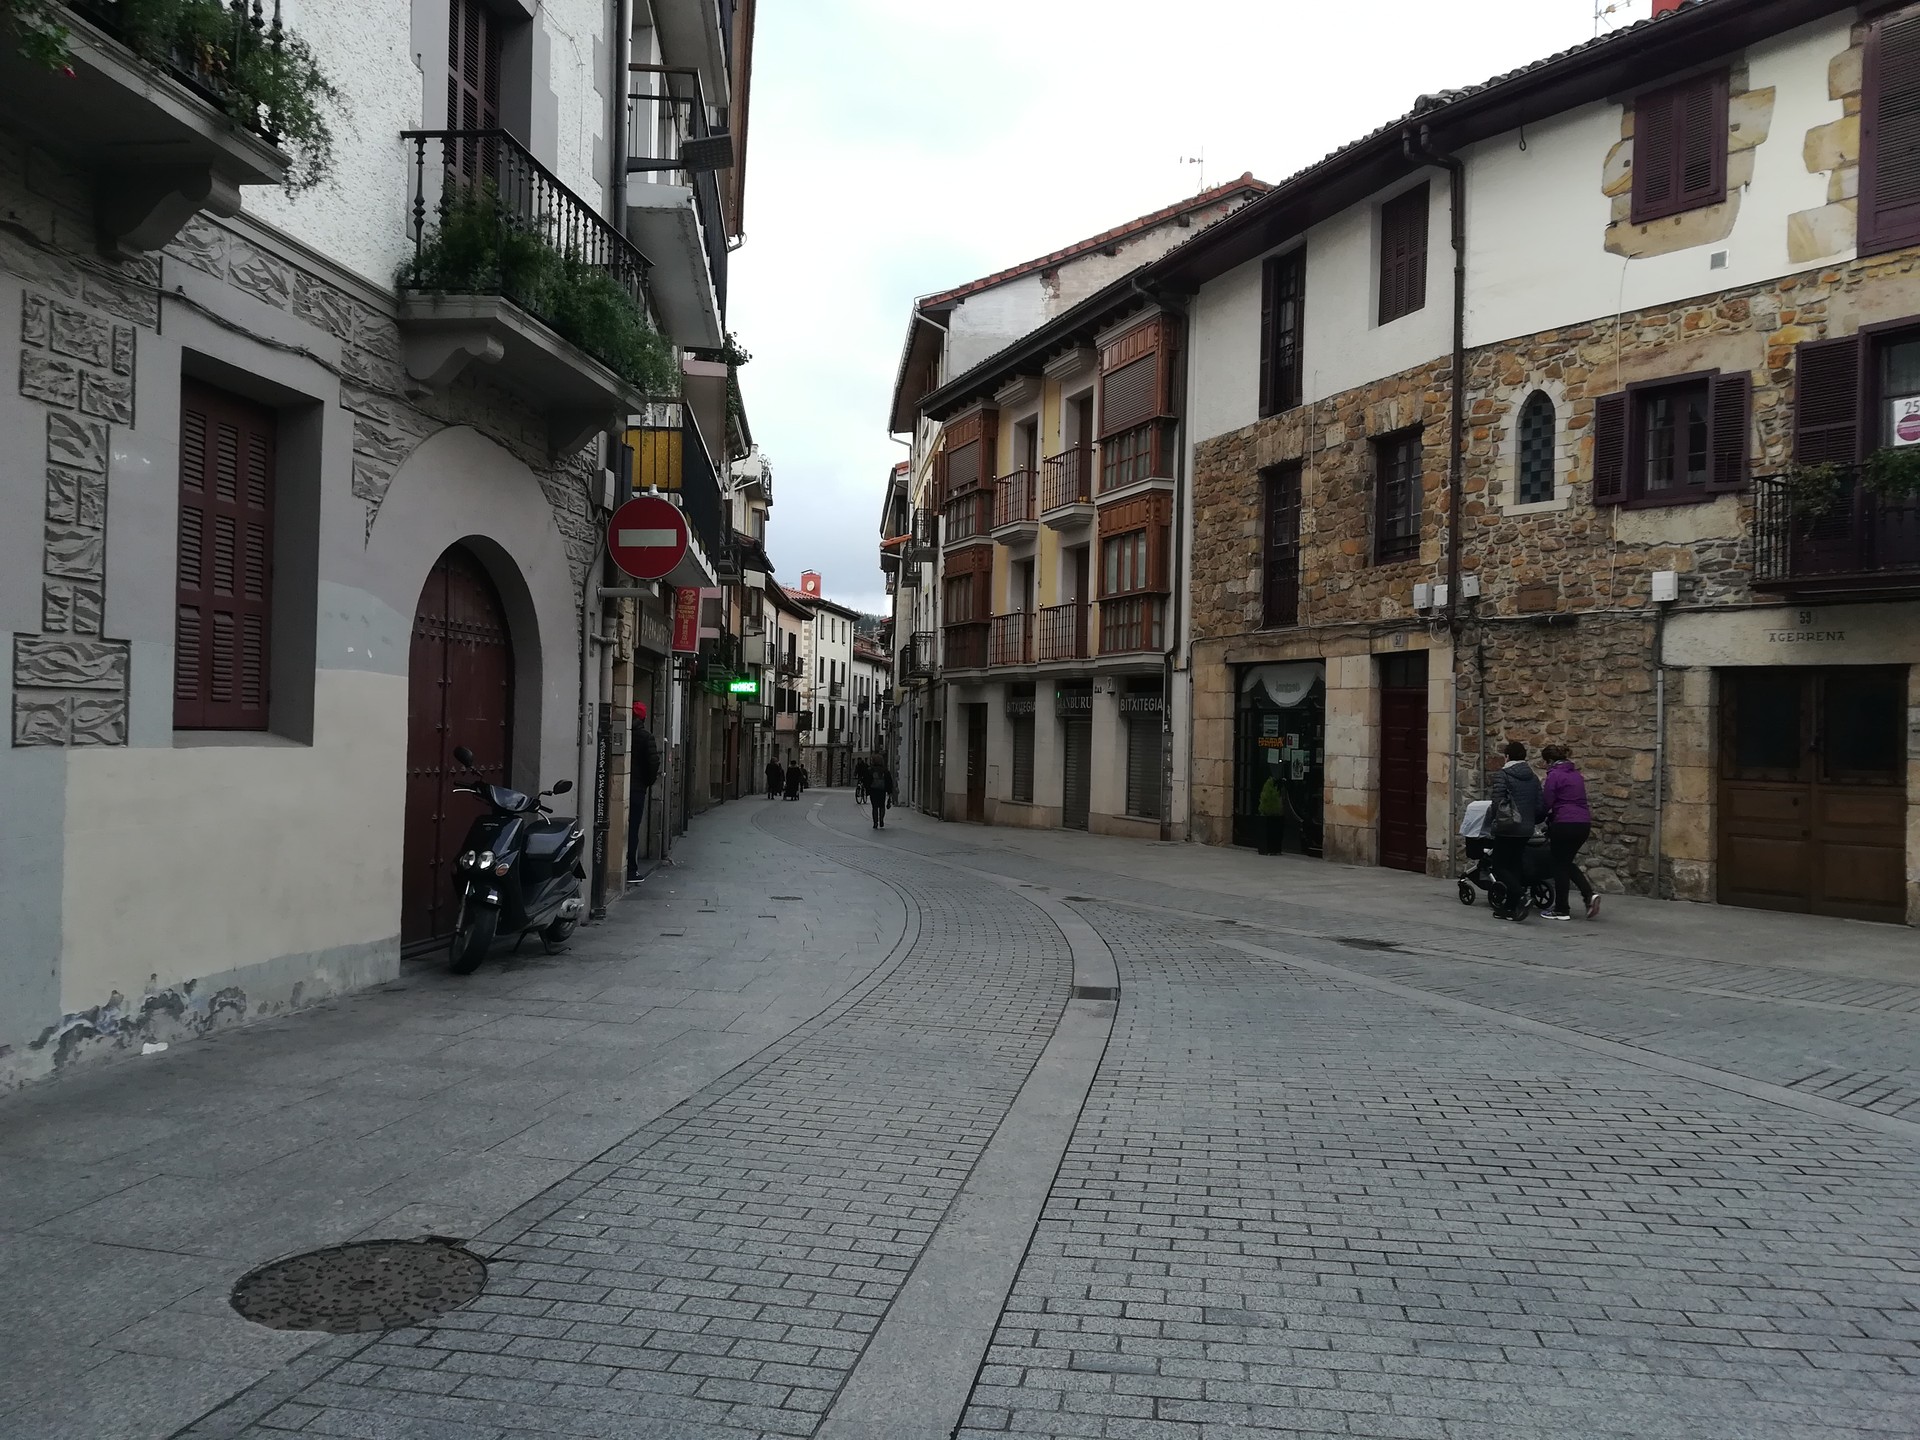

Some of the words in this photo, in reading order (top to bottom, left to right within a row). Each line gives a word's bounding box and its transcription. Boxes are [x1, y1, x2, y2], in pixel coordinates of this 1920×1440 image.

[1800, 611, 1811, 625] 59
[1768, 631, 1846, 642] AGERRENA
[1120, 697, 1163, 711] BITXITEGIA
